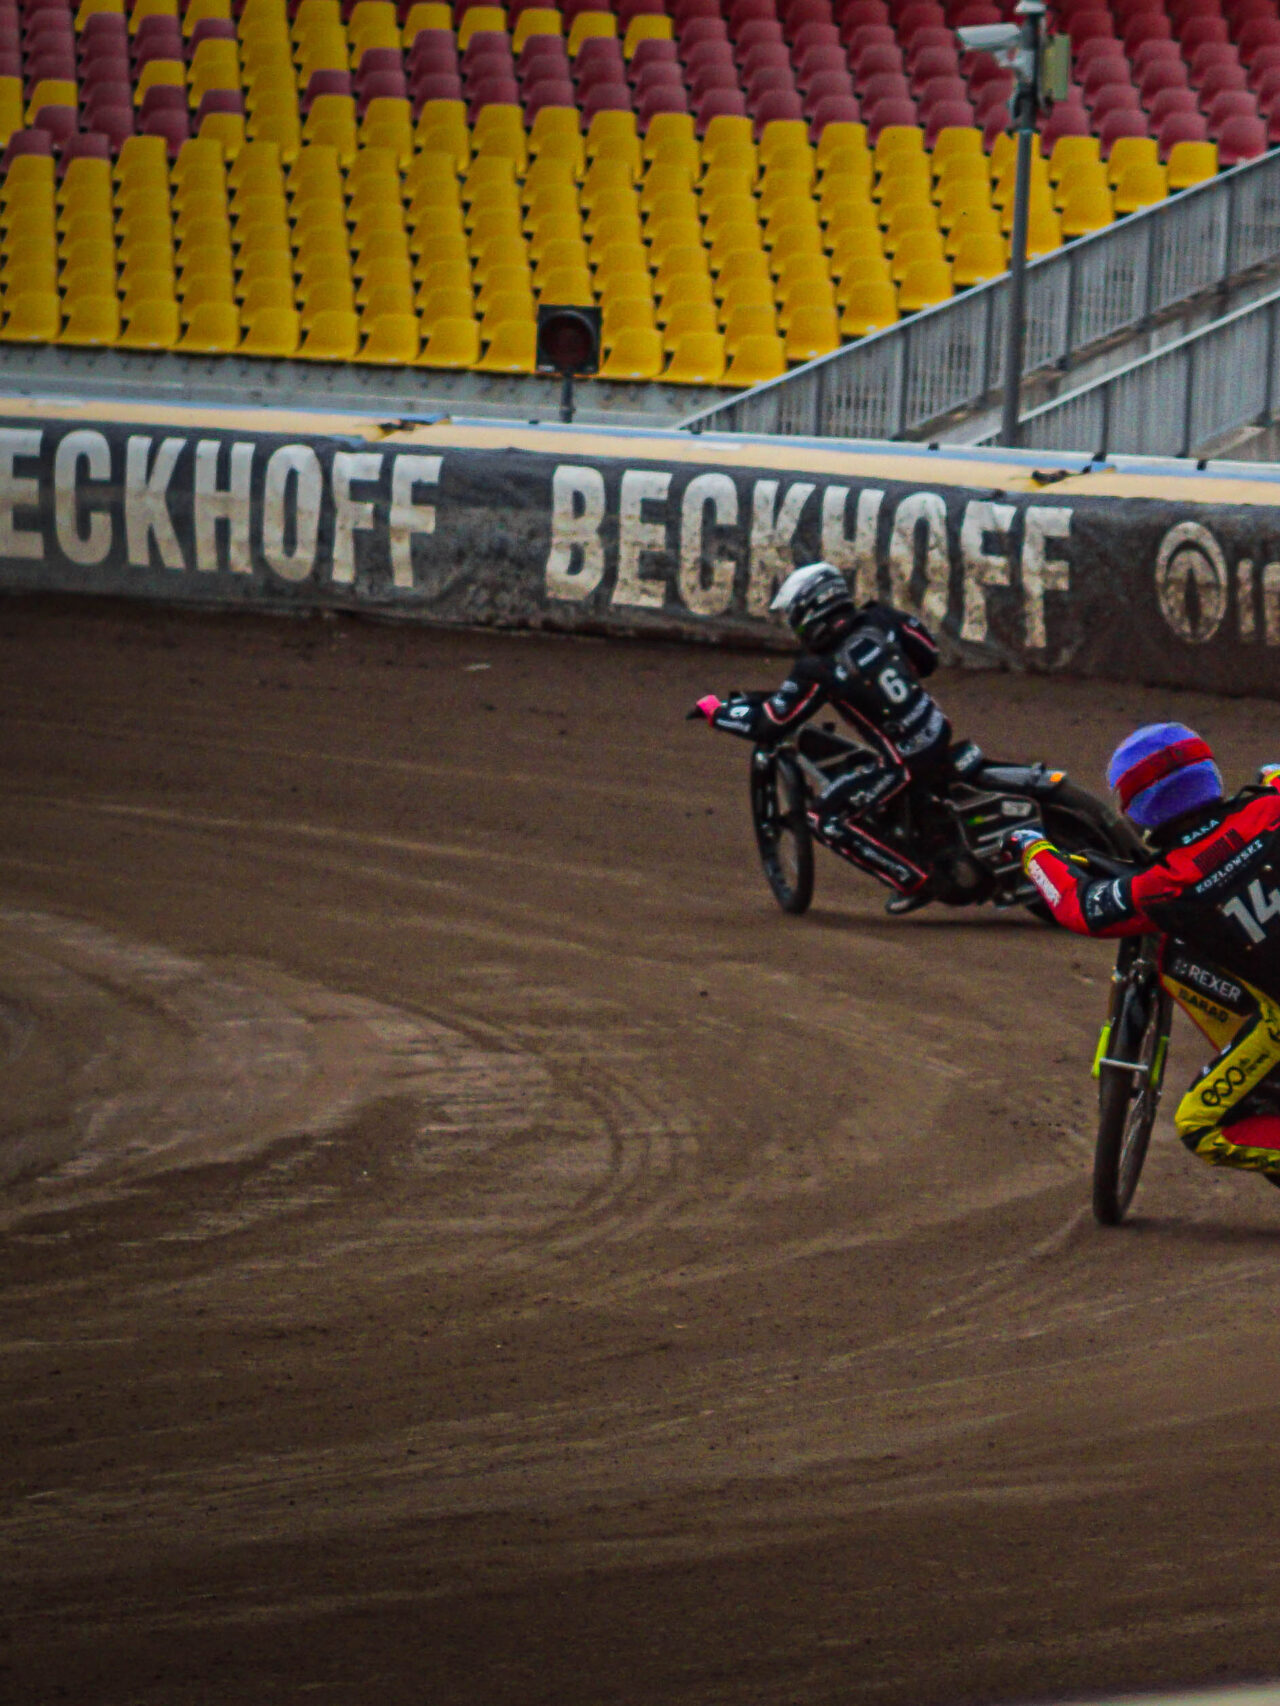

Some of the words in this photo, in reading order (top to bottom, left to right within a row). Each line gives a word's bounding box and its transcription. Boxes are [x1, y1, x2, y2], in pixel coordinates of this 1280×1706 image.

[0, 427, 443, 588] ECKHOFF
[545, 465, 1074, 648] BECKHOFF
[879, 667, 908, 703] 6
